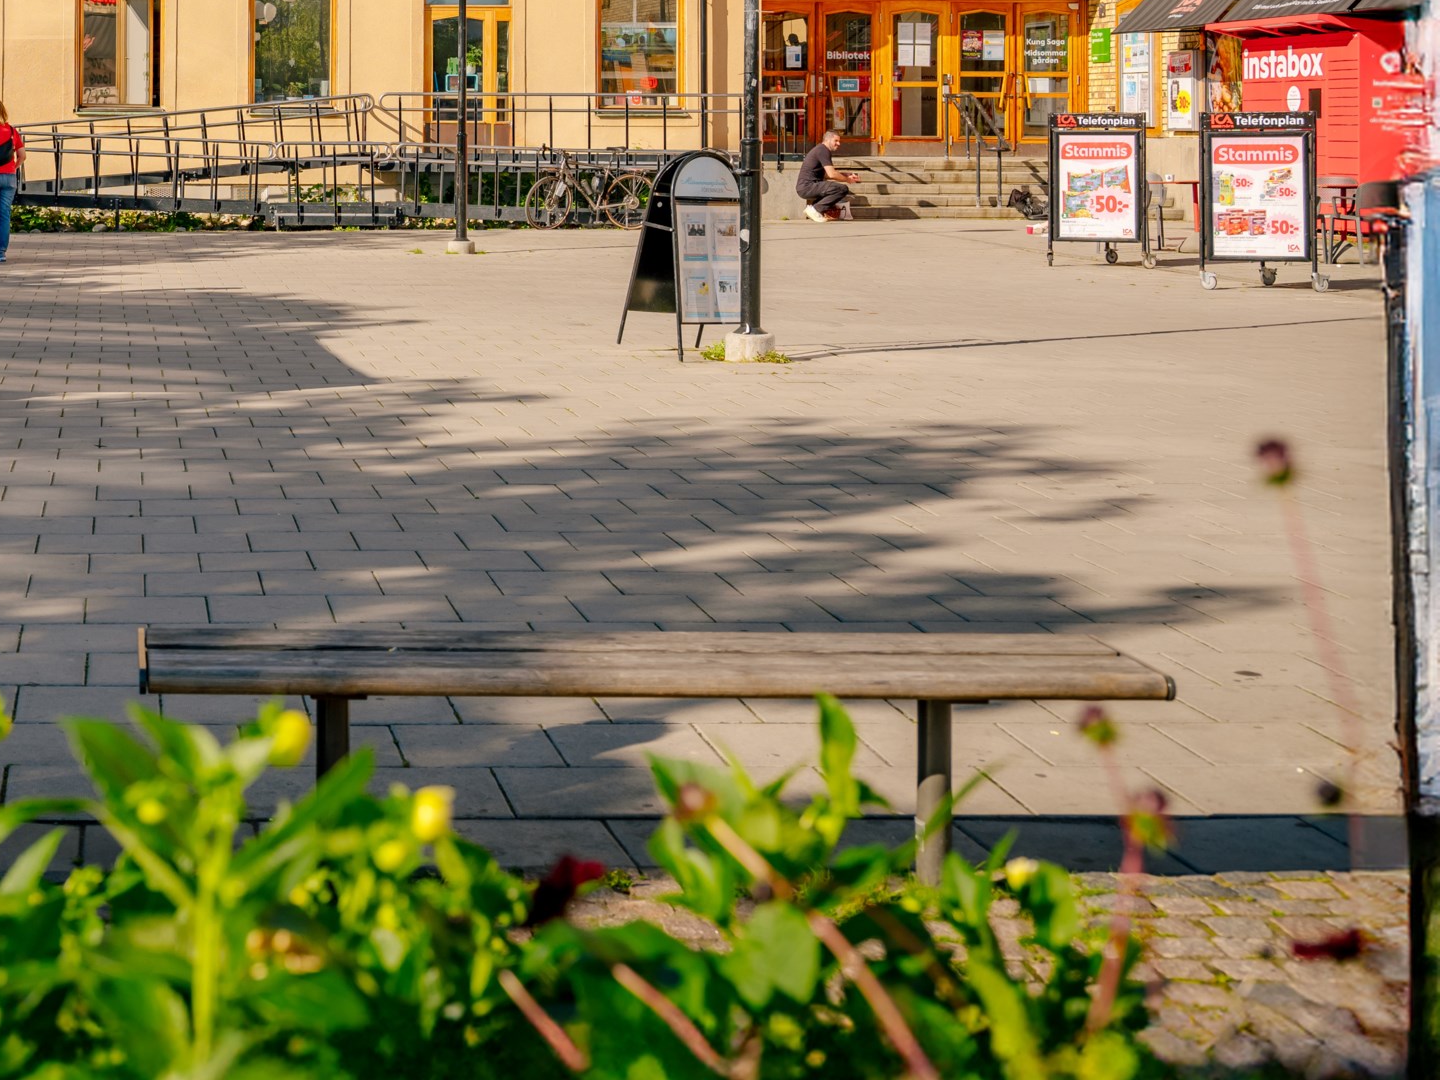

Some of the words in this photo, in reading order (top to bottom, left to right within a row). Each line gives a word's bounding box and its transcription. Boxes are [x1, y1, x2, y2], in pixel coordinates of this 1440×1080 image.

[1026, 38, 1045, 46] Kung
[1046, 38, 1065, 46] Saga
[826, 50, 870, 60] Bibliotek
[1024, 49, 1067, 57] Midsommar
[1032, 56, 1059, 65] gården
[1243, 45, 1323, 80] instabox
[1057, 114, 1076, 124] ICA
[1077, 116, 1136, 126] Telefonplan
[1210, 113, 1234, 124] ICA
[1235, 115, 1305, 127] Telefonplan
[1065, 144, 1128, 157] Stammis
[1218, 146, 1293, 161] Stammis
[1235, 178, 1253, 187] 50:-
[1279, 188, 1297, 197] 50:-
[1095, 195, 1129, 213] 50:-
[1271, 220, 1299, 235] 50:-
